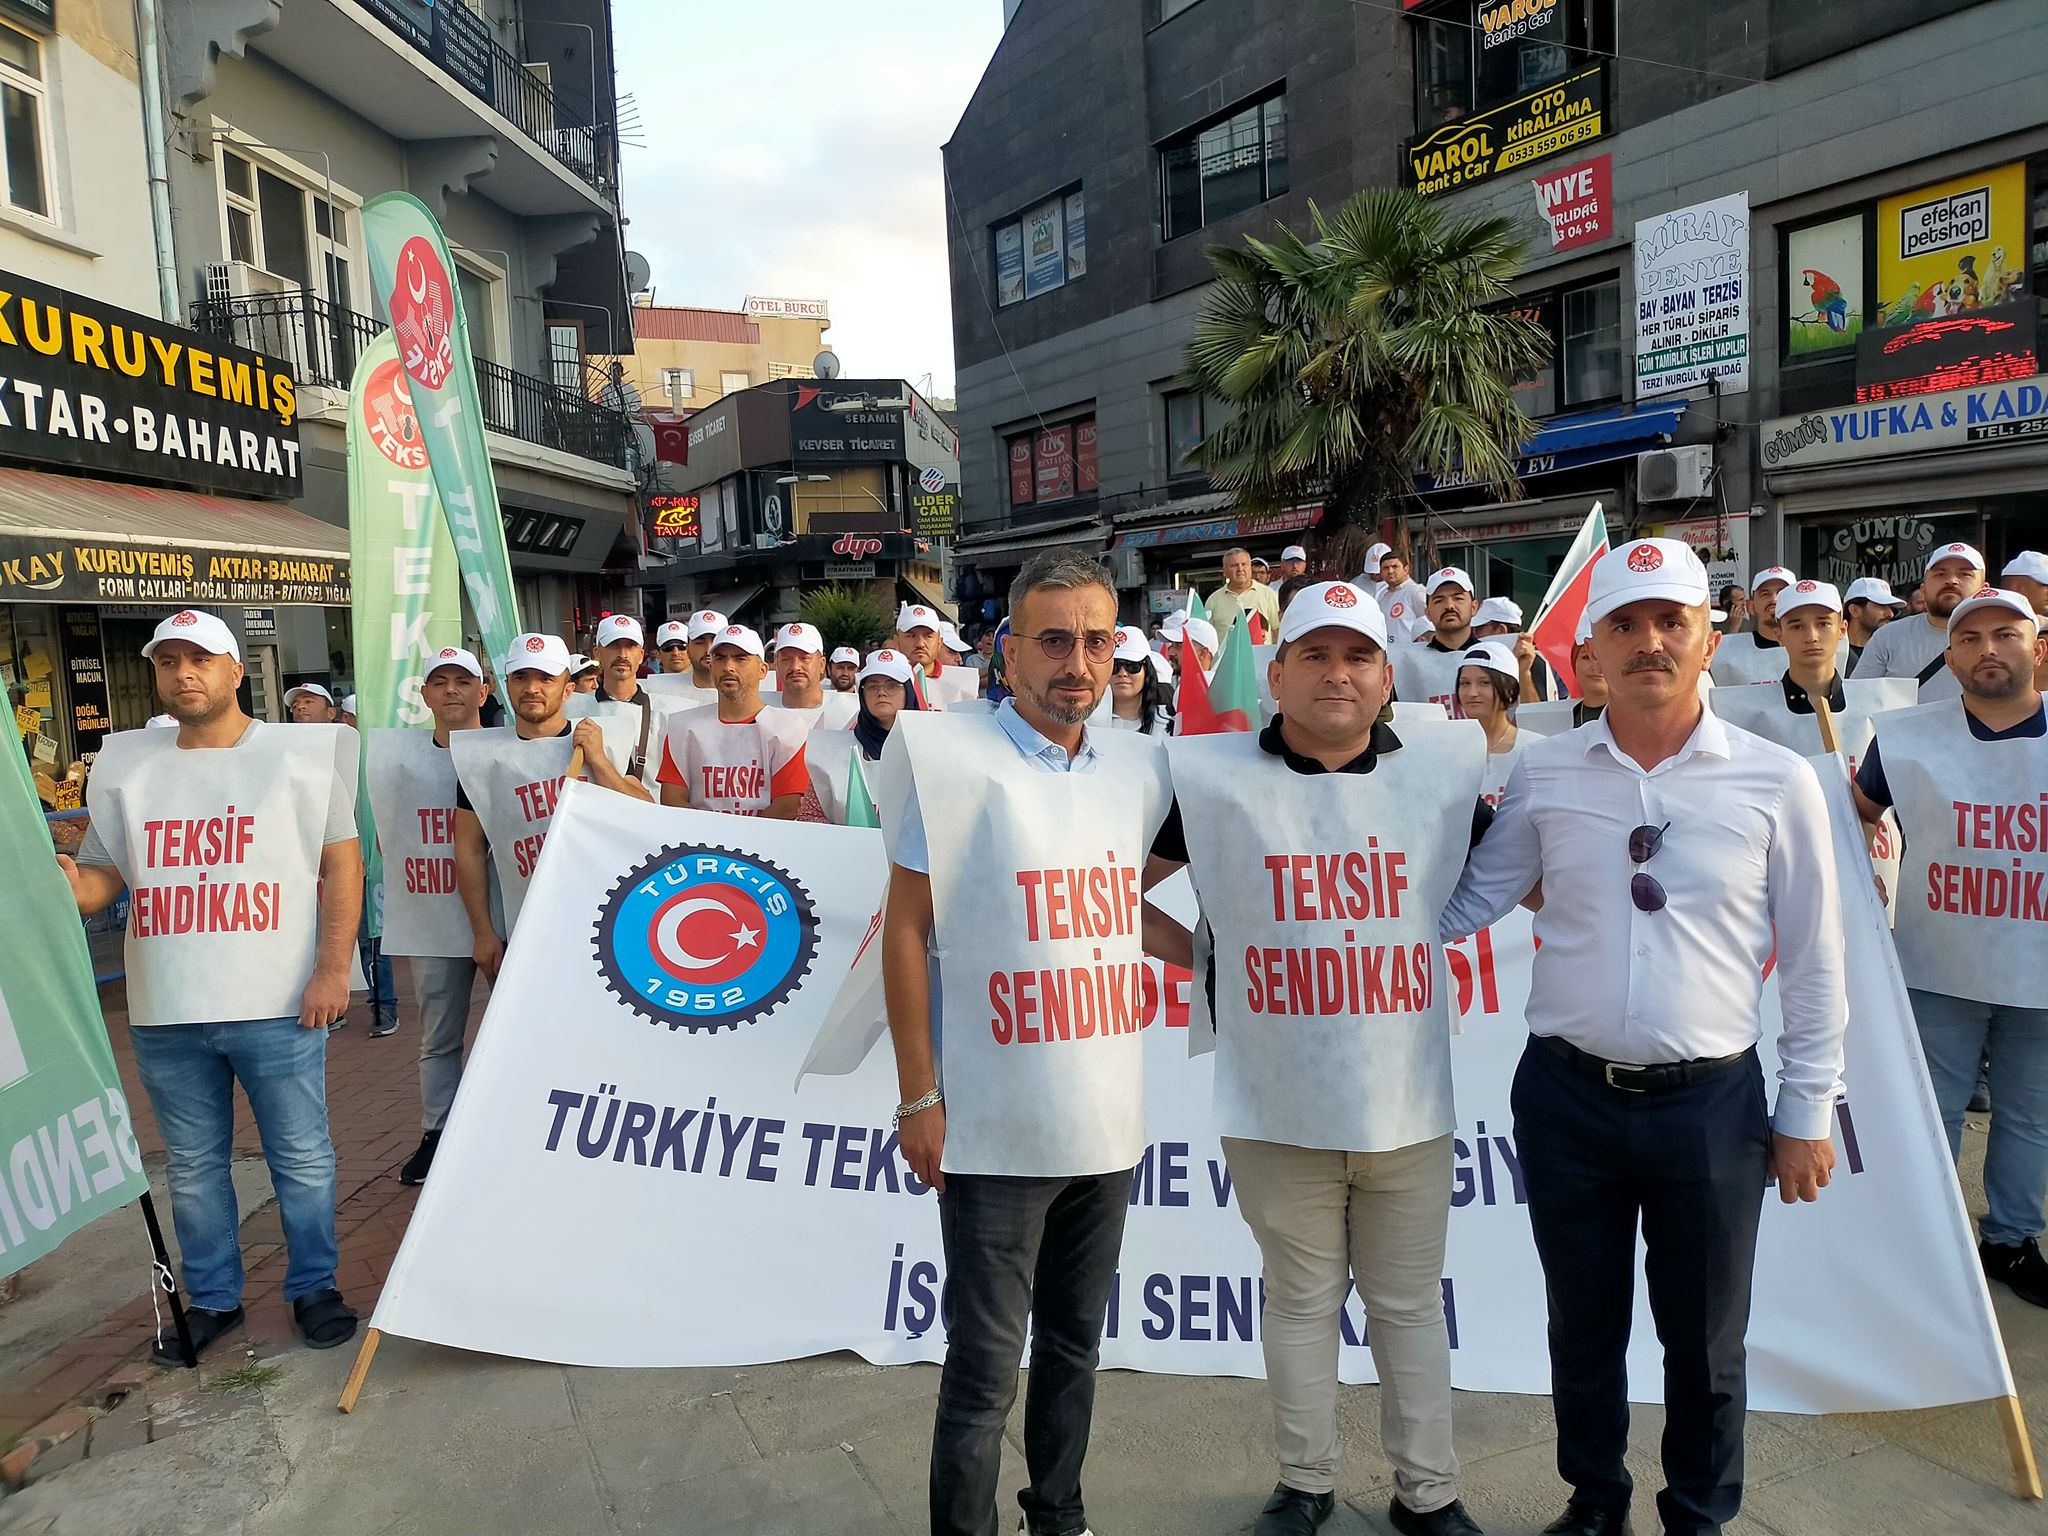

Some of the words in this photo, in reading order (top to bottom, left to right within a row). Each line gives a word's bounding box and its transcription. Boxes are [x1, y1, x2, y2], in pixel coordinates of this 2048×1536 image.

[1484, 26, 1516, 49] Rent
[1517, 22, 1527, 35] a
[1528, 9, 1553, 30] Car
[1530, 90, 1565, 114] OTO
[1507, 97, 1592, 142] KİRALAMA
[1414, 133, 1494, 181] VAROL
[1508, 147, 1534, 164] 0533
[1537, 139, 1556, 156] 559
[1559, 132, 1574, 148] 06
[1577, 124, 1592, 141] 95
[1417, 172, 1450, 196] Rent
[1452, 170, 1461, 184] a
[1464, 159, 1490, 181] Car
[1568, 224, 1582, 239] 04
[1584, 220, 1598, 236] 94
[1921, 198, 1981, 228] efekan
[1639, 211, 1744, 269] MİRAY
[1907, 218, 1982, 253] petshop
[1641, 249, 1741, 295] PENYE
[750, 300, 781, 312] OTEL
[785, 301, 824, 315] BURCU
[1640, 299, 1657, 320] BAY
[1702, 274, 1742, 308] TERZİSİ
[1642, 323, 1660, 337] HER
[1663, 312, 1695, 332] TÜRLÜ
[1699, 303, 1739, 325] SİPARİŞ
[1651, 333, 1682, 351] ALINIR
[1692, 322, 1729, 343] DİKİLİR
[1639, 355, 1654, 372] TÜM
[1655, 349, 1688, 370] TAMİRLİK
[1690, 342, 1714, 366] İŞLERİ
[1716, 338, 1746, 357] YAPILIR
[1642, 375, 1663, 391] TERZİ
[1665, 368, 1698, 386] NURGÜL
[845, 412, 898, 424] SERAMİK
[1764, 415, 1828, 464] GÜMÜŞ
[1830, 402, 1934, 442] YUFKA
[1940, 401, 1958, 428] &
[1975, 422, 2014, 440] TEL:
[799, 439, 843, 451] KEVSER
[850, 437, 896, 450] TİCARET
[913, 495, 954, 507] LİDER
[920, 505, 950, 517] CAM
[833, 532, 882, 560] dyo
[1833, 513, 1935, 551] GÜMÜŞ
[0, 550, 65, 587] KAY
[75, 547, 194, 588] KURUYEMİŞ
[1711, 572, 1735, 580] KÖMÜR
[99, 578, 134, 599] FORM
[325, 583, 352, 602] YAĞLA
[71, 657, 101, 670] BİTKİSEL
[76, 703, 100, 717] DOĞAL
[77, 717, 110, 731] ÜRÜNLER
[702, 759, 765, 798] TEKSİF
[144, 805, 255, 869] TEKSİF
[1264, 836, 1408, 922] TEKSİF
[1927, 858, 2048, 922] SENDİK
[1015, 851, 1138, 942] TEKSİF
[1244, 929, 1432, 1017] SENDİKASI
[645, 977, 746, 1011] 1952
[543, 1083, 786, 1184] TÜRKİYE
